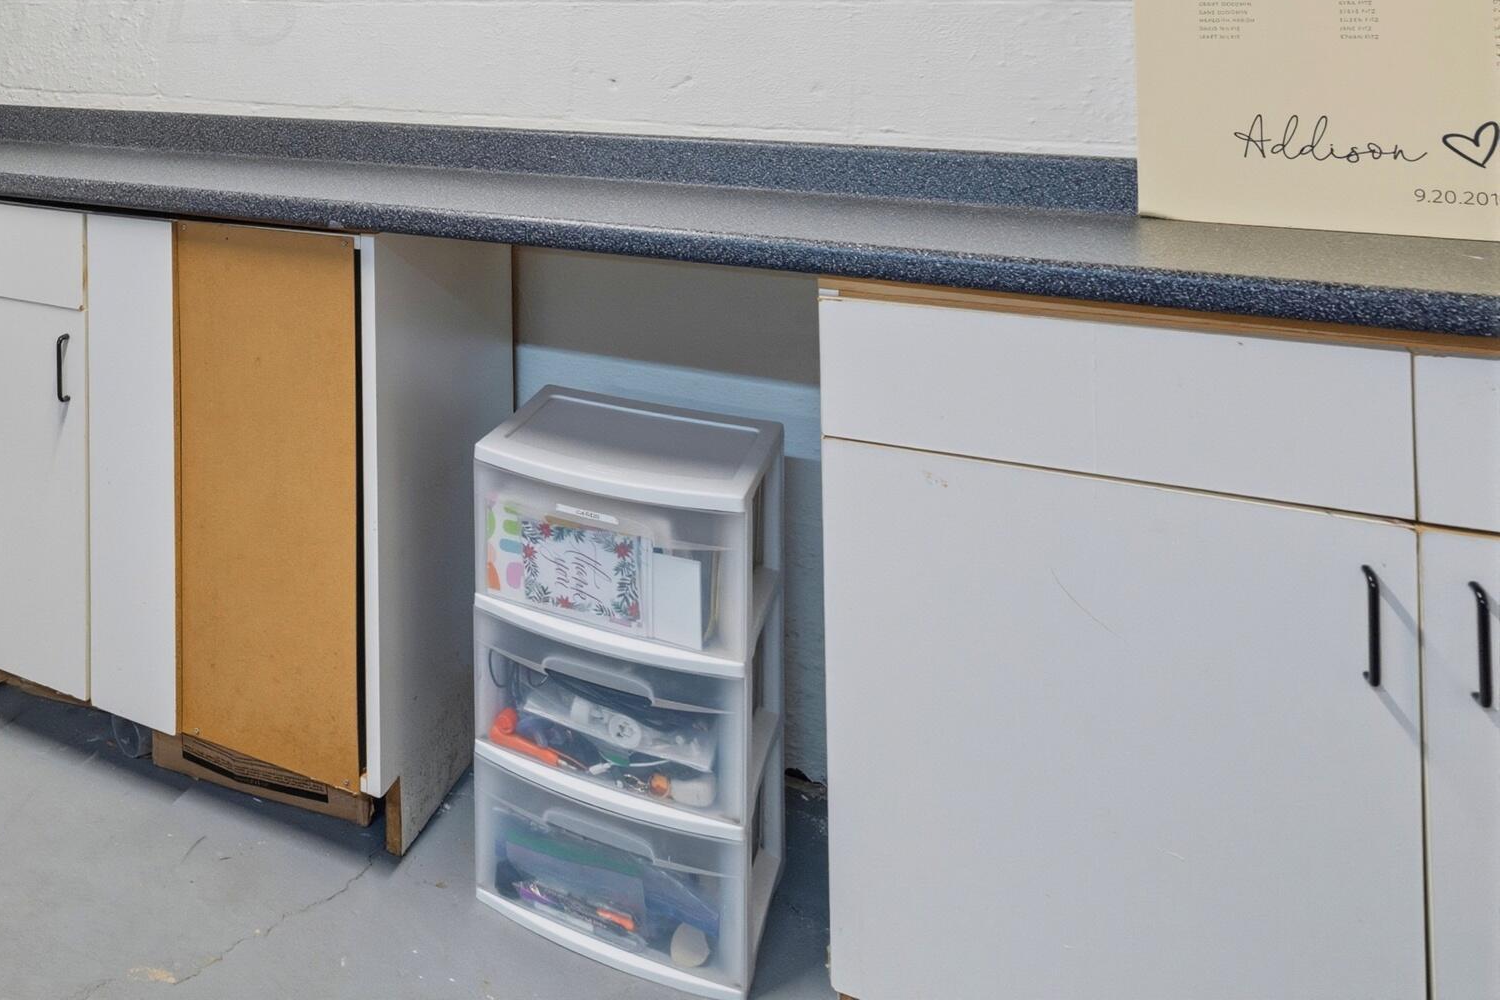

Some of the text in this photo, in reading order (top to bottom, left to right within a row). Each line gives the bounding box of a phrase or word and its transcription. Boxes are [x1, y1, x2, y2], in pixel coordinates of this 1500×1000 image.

[1233, 113, 1428, 163] Addison
[539, 544, 570, 589] you
[563, 543, 612, 602] thank
